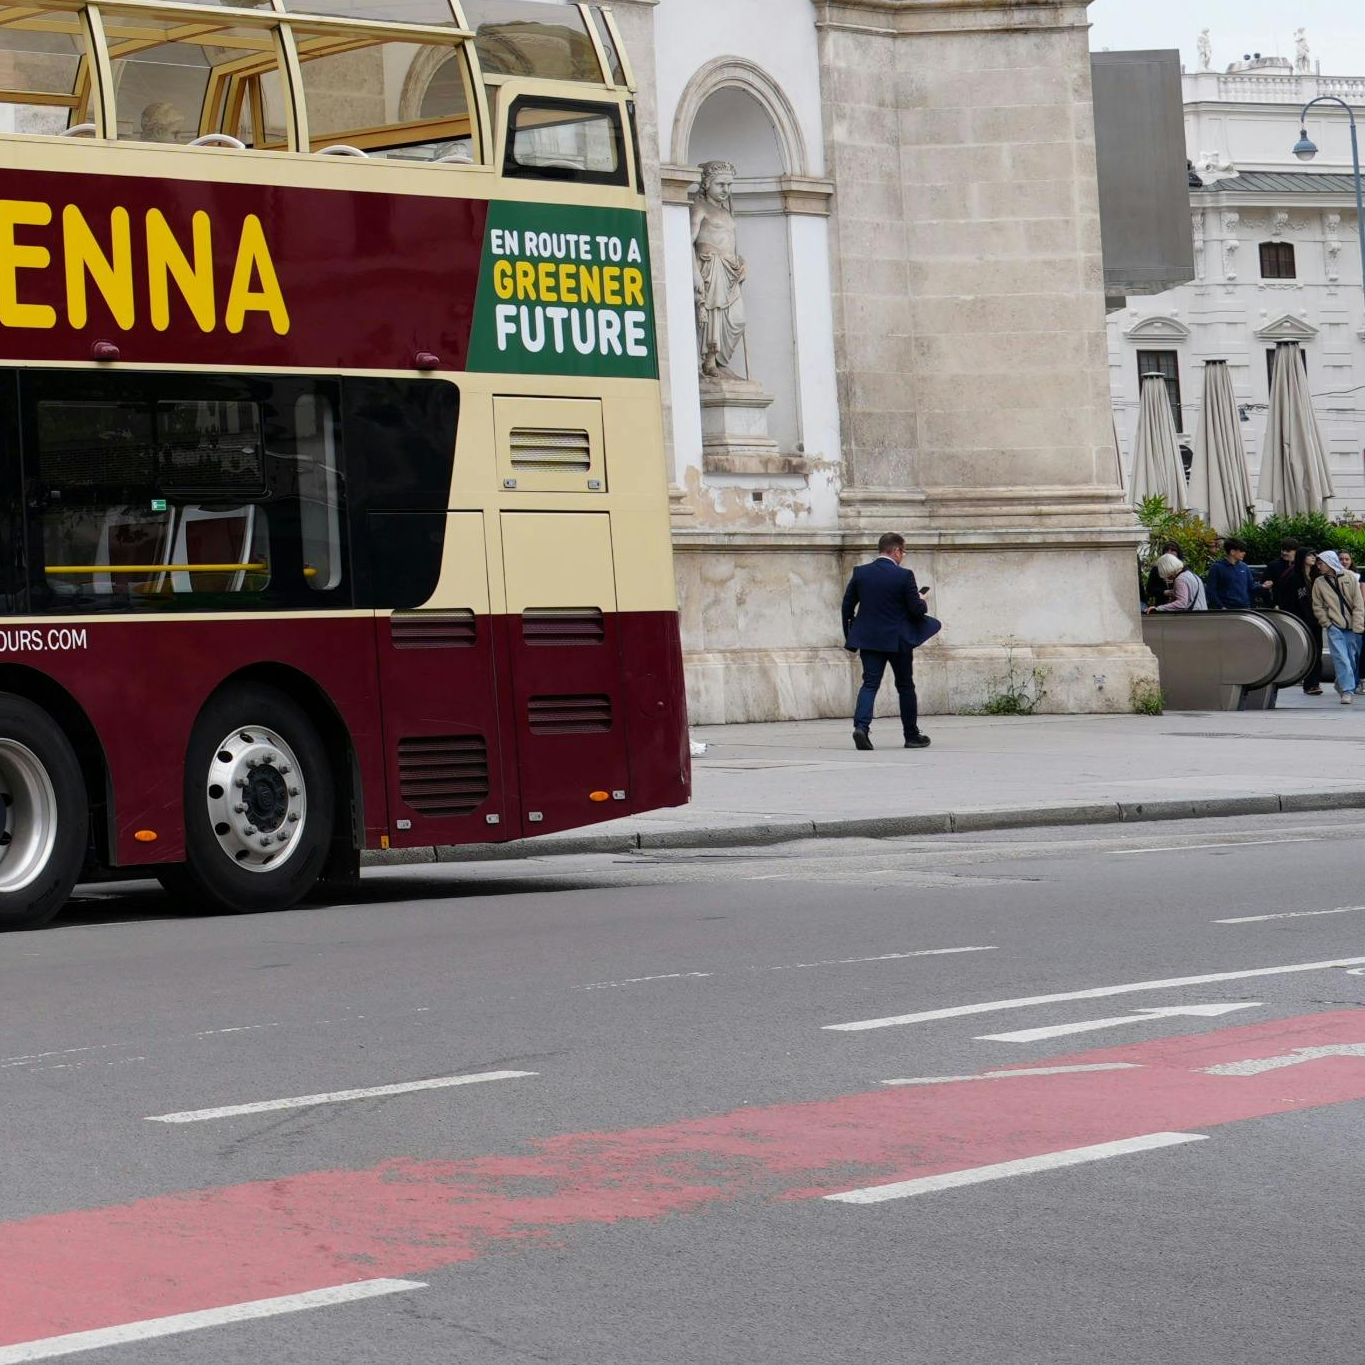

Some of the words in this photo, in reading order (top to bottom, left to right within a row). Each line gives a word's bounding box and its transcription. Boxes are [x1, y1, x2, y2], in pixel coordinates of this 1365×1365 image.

[490, 228, 520, 256] EN
[525, 232, 592, 260] ROUTE
[595, 235, 623, 262] TO
[627, 237, 642, 263] A
[492, 259, 645, 307] GREENER
[494, 304, 649, 357] FUTURE
